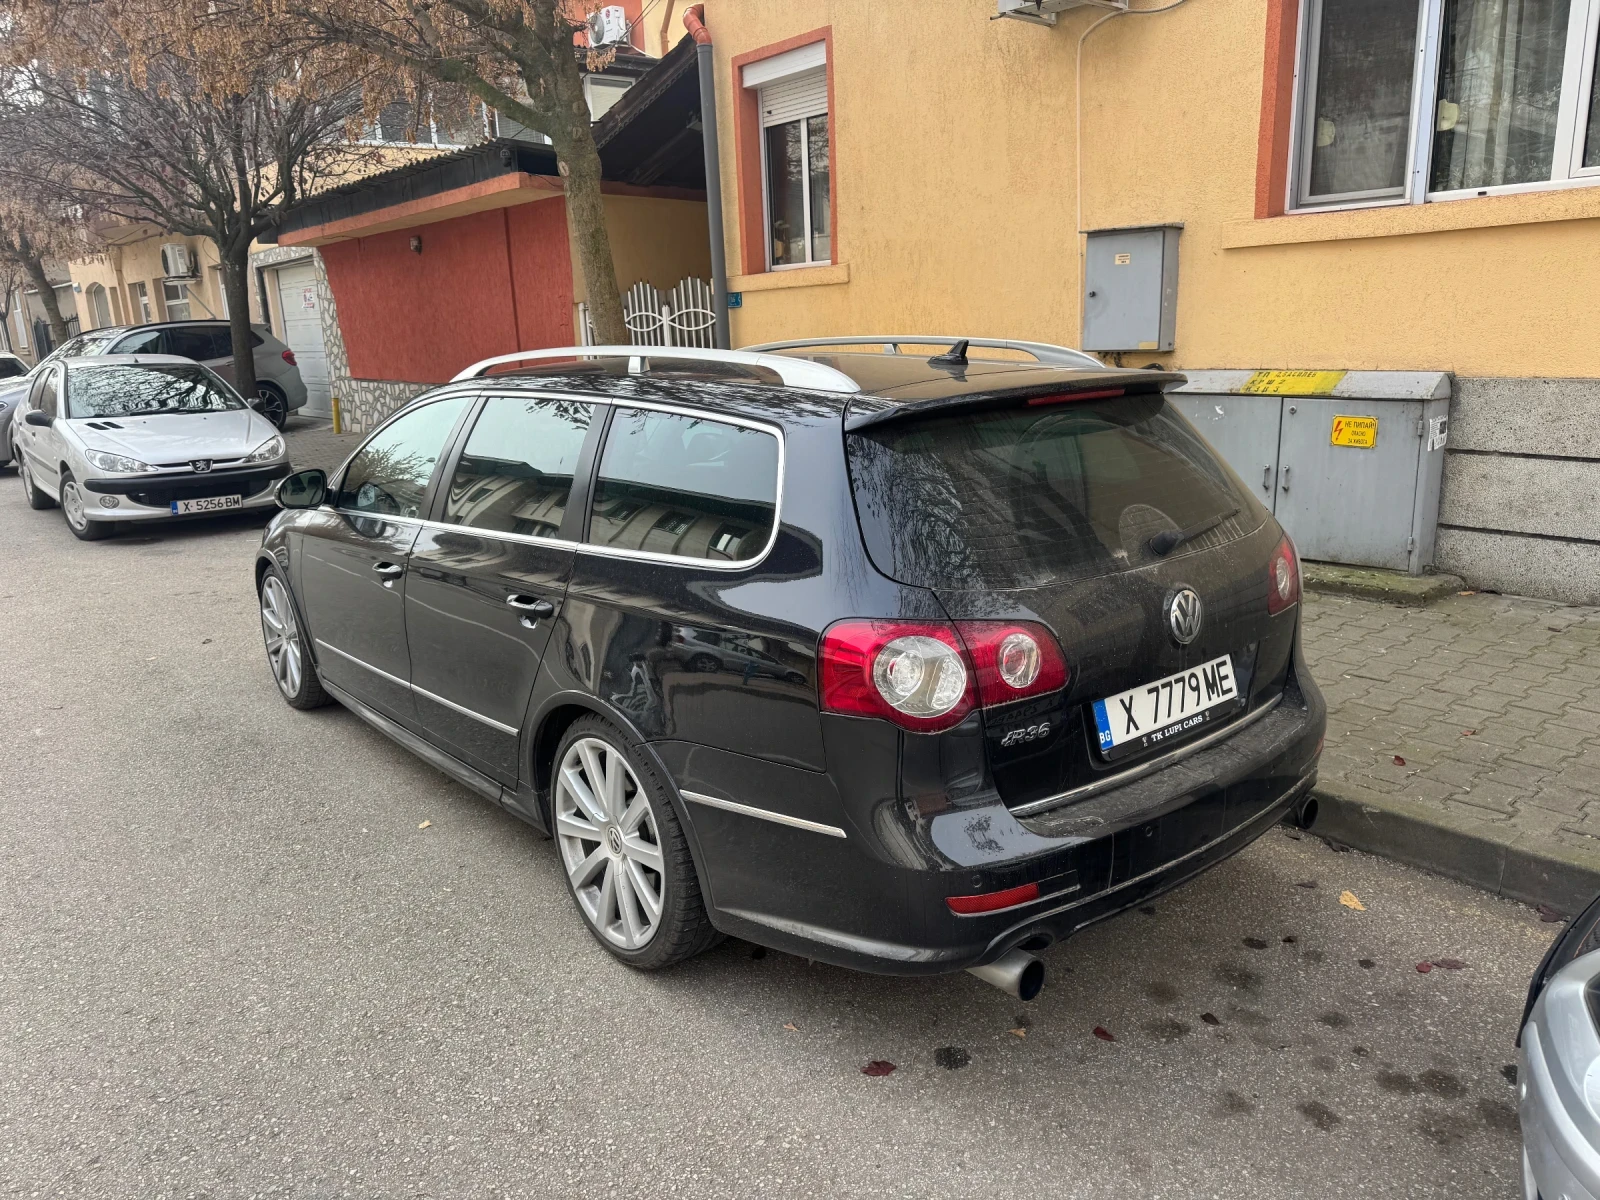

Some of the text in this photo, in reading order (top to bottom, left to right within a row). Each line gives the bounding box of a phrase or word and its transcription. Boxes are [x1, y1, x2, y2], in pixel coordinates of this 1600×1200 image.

[1353, 421, 1375, 429] ПИПАЙ!
[196, 498, 223, 511] 5256
[225, 496, 240, 507] BM
[1119, 659, 1233, 735] X 7779 ME
[1151, 715, 1203, 742] TK LUPI CARS
[1100, 730, 1111, 743] BG
